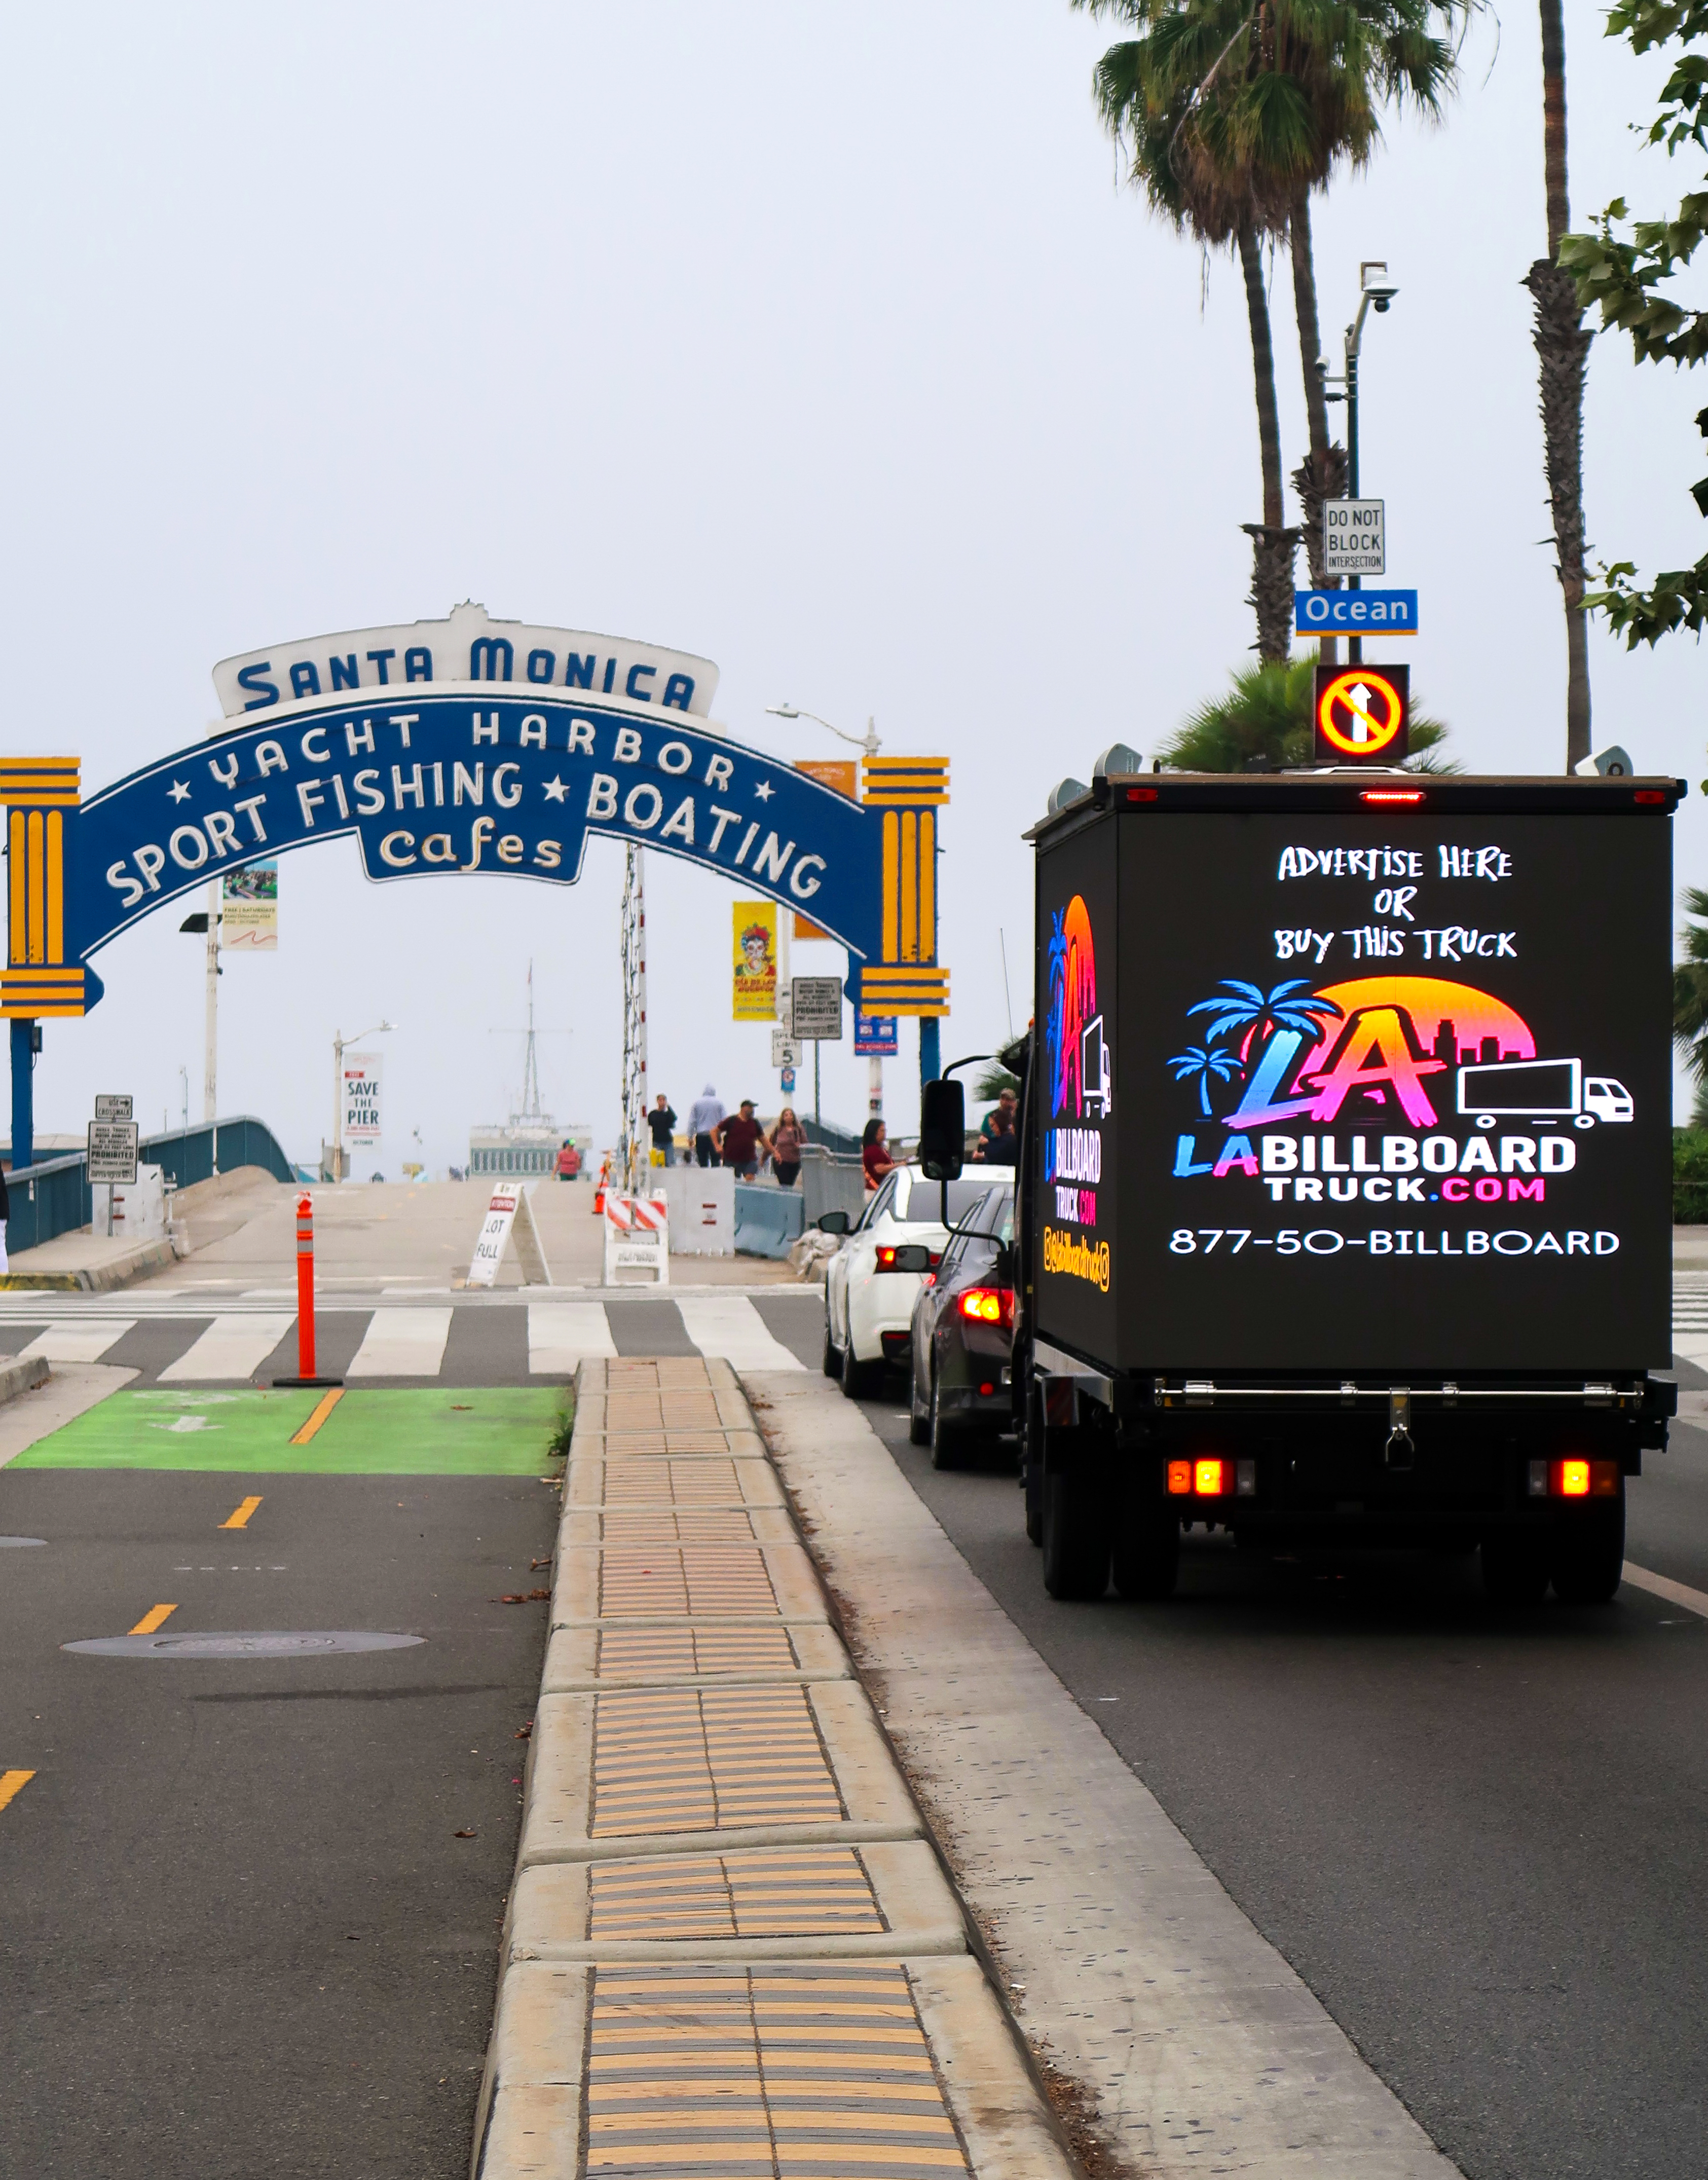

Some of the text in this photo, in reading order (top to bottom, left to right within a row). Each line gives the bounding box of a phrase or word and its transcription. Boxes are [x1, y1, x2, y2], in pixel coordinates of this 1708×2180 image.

[1329, 509, 1380, 527] DO NOT
[1329, 534, 1381, 551] BLOCK
[1328, 556, 1382, 568] INTERSECTION
[1306, 596, 1408, 621] Ocean
[238, 637, 695, 712] SANTA MONICA
[208, 712, 734, 792] YACHT HARBOR
[106, 761, 828, 908] SPORT FISHING BOATING
[1277, 845, 1513, 882] ADVERTISE HERE
[1373, 886, 1418, 921] OR
[1274, 925, 1517, 964] BUY THIS TRUCK
[783, 1049, 793, 1063] 5
[348, 1081, 380, 1095] SAVE
[355, 1098, 373, 1107] THE
[348, 1110, 379, 1124] PIER
[91, 1151, 134, 1159] PROHIBITED
[1263, 1177, 1546, 1203] TRUCK.COM
[486, 1220, 505, 1234] LOT
[477, 1243, 498, 1259] FULL
[1169, 1229, 1620, 1255] 877-50-BILLBOARD
